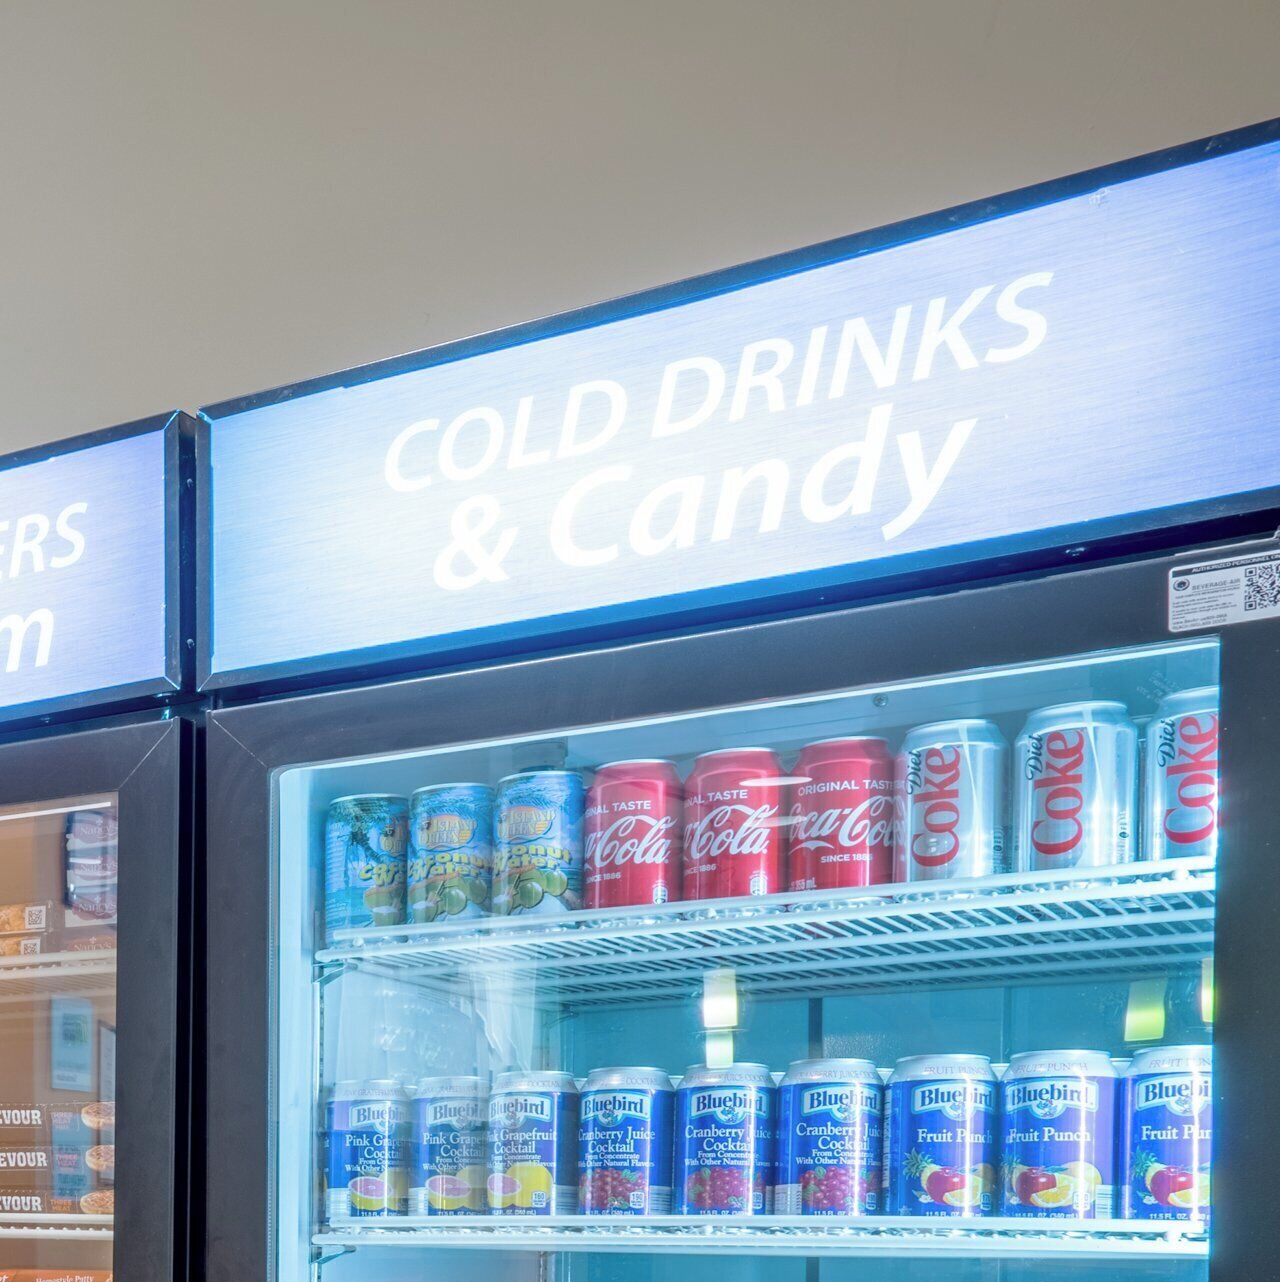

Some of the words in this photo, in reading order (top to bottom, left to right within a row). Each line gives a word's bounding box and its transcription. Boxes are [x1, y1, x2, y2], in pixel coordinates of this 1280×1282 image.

[384, 375, 628, 494] COLD
[651, 269, 1055, 439] DRINKS
[433, 491, 522, 593] &
[549, 401, 978, 569] Candy
[1158, 717, 1176, 768] Diet
[1025, 733, 1042, 781] Diet
[906, 750, 921, 796] Diet
[1163, 711, 1219, 845] Coke
[708, 789, 748, 802] TASTE
[1031, 728, 1085, 855] Coke
[911, 745, 961, 868] Coke
[583, 1094, 644, 1115] Bluebird
[695, 1092, 764, 1113] Bluebird
[1011, 1083, 1089, 1106] Bluebird
[491, 1097, 545, 1118] Bluebird
[345, 1134, 369, 1147] Pink
[422, 1132, 447, 1146] Pink
[500, 1128, 557, 1144] Grapefruit
[578, 1127, 623, 1142] Cranberry
[626, 1126, 655, 1140] Juice
[1008, 1128, 1040, 1143] Fruit
[1042, 1126, 1091, 1142] Punch
[1141, 1125, 1178, 1141] Fruit
[494, 1140, 536, 1155] Cocktail
[588, 1139, 635, 1153] Cocktail
